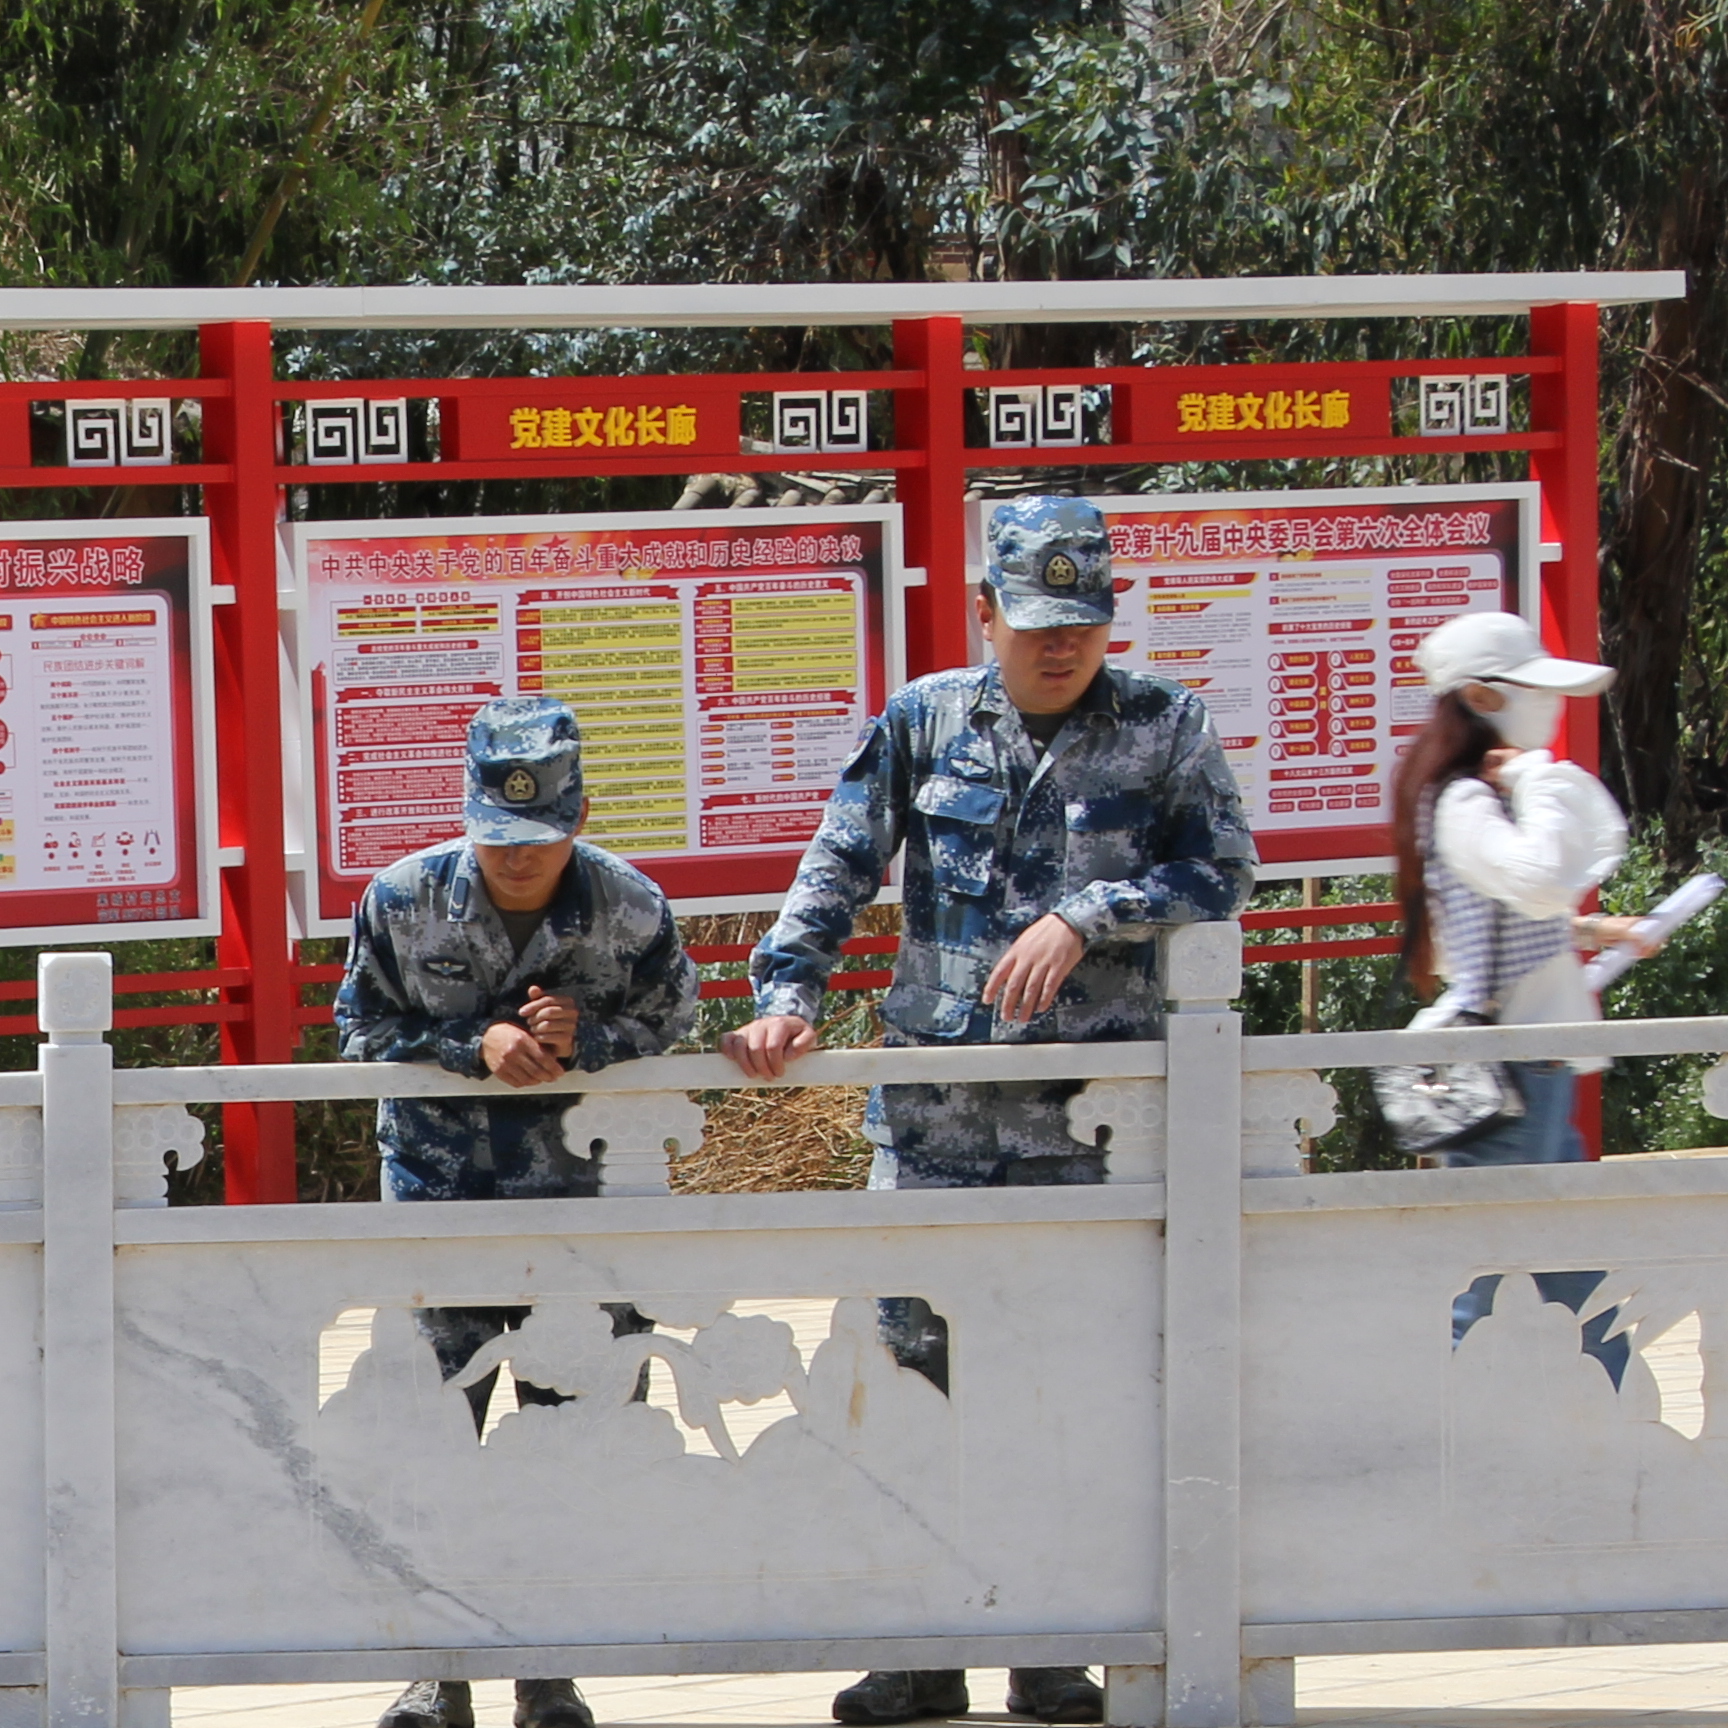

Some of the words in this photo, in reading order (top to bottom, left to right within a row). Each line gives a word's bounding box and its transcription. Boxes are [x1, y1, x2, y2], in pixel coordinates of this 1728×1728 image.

[508, 404, 697, 450] 党建文化长廊
[1176, 389, 1350, 433] 党建文化长廊
[321, 534, 864, 581] 中共中央关于党的百年奋斗重大成就和历史经验的决议
[1106, 511, 1490, 559] 党第十九届中央委员会第六次全体会议
